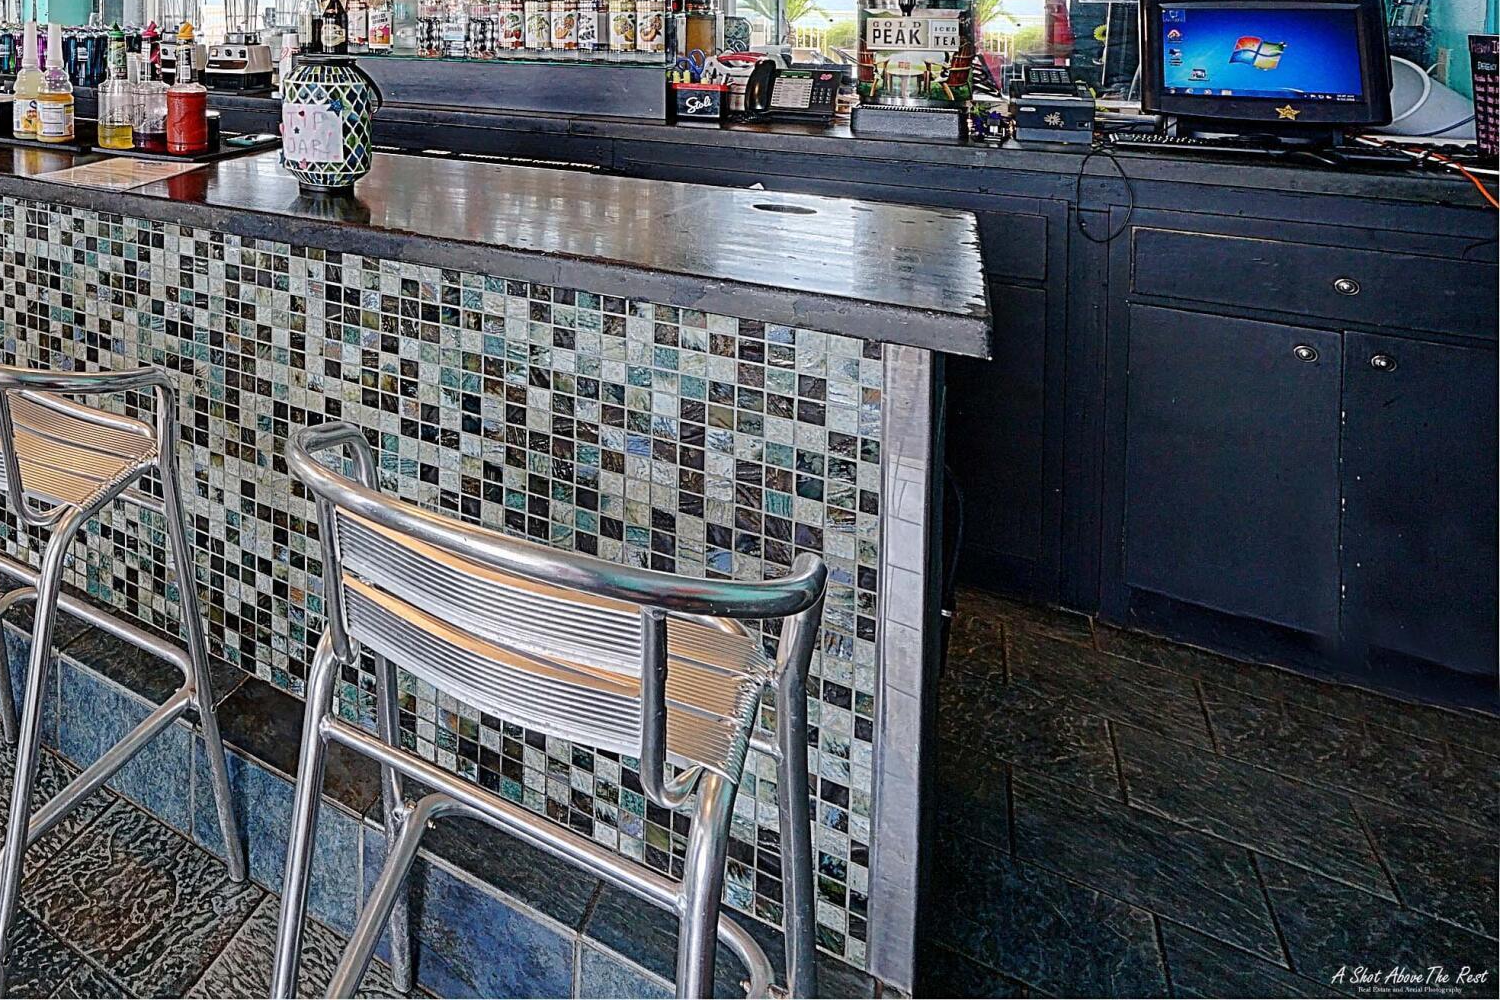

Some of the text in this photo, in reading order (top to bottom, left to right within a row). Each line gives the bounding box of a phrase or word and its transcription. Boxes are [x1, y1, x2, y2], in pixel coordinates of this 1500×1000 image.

[872, 20, 921, 28] GOLD
[872, 28, 921, 45] PEAK
[934, 35, 957, 46] TEA
[287, 111, 324, 130] TIP
